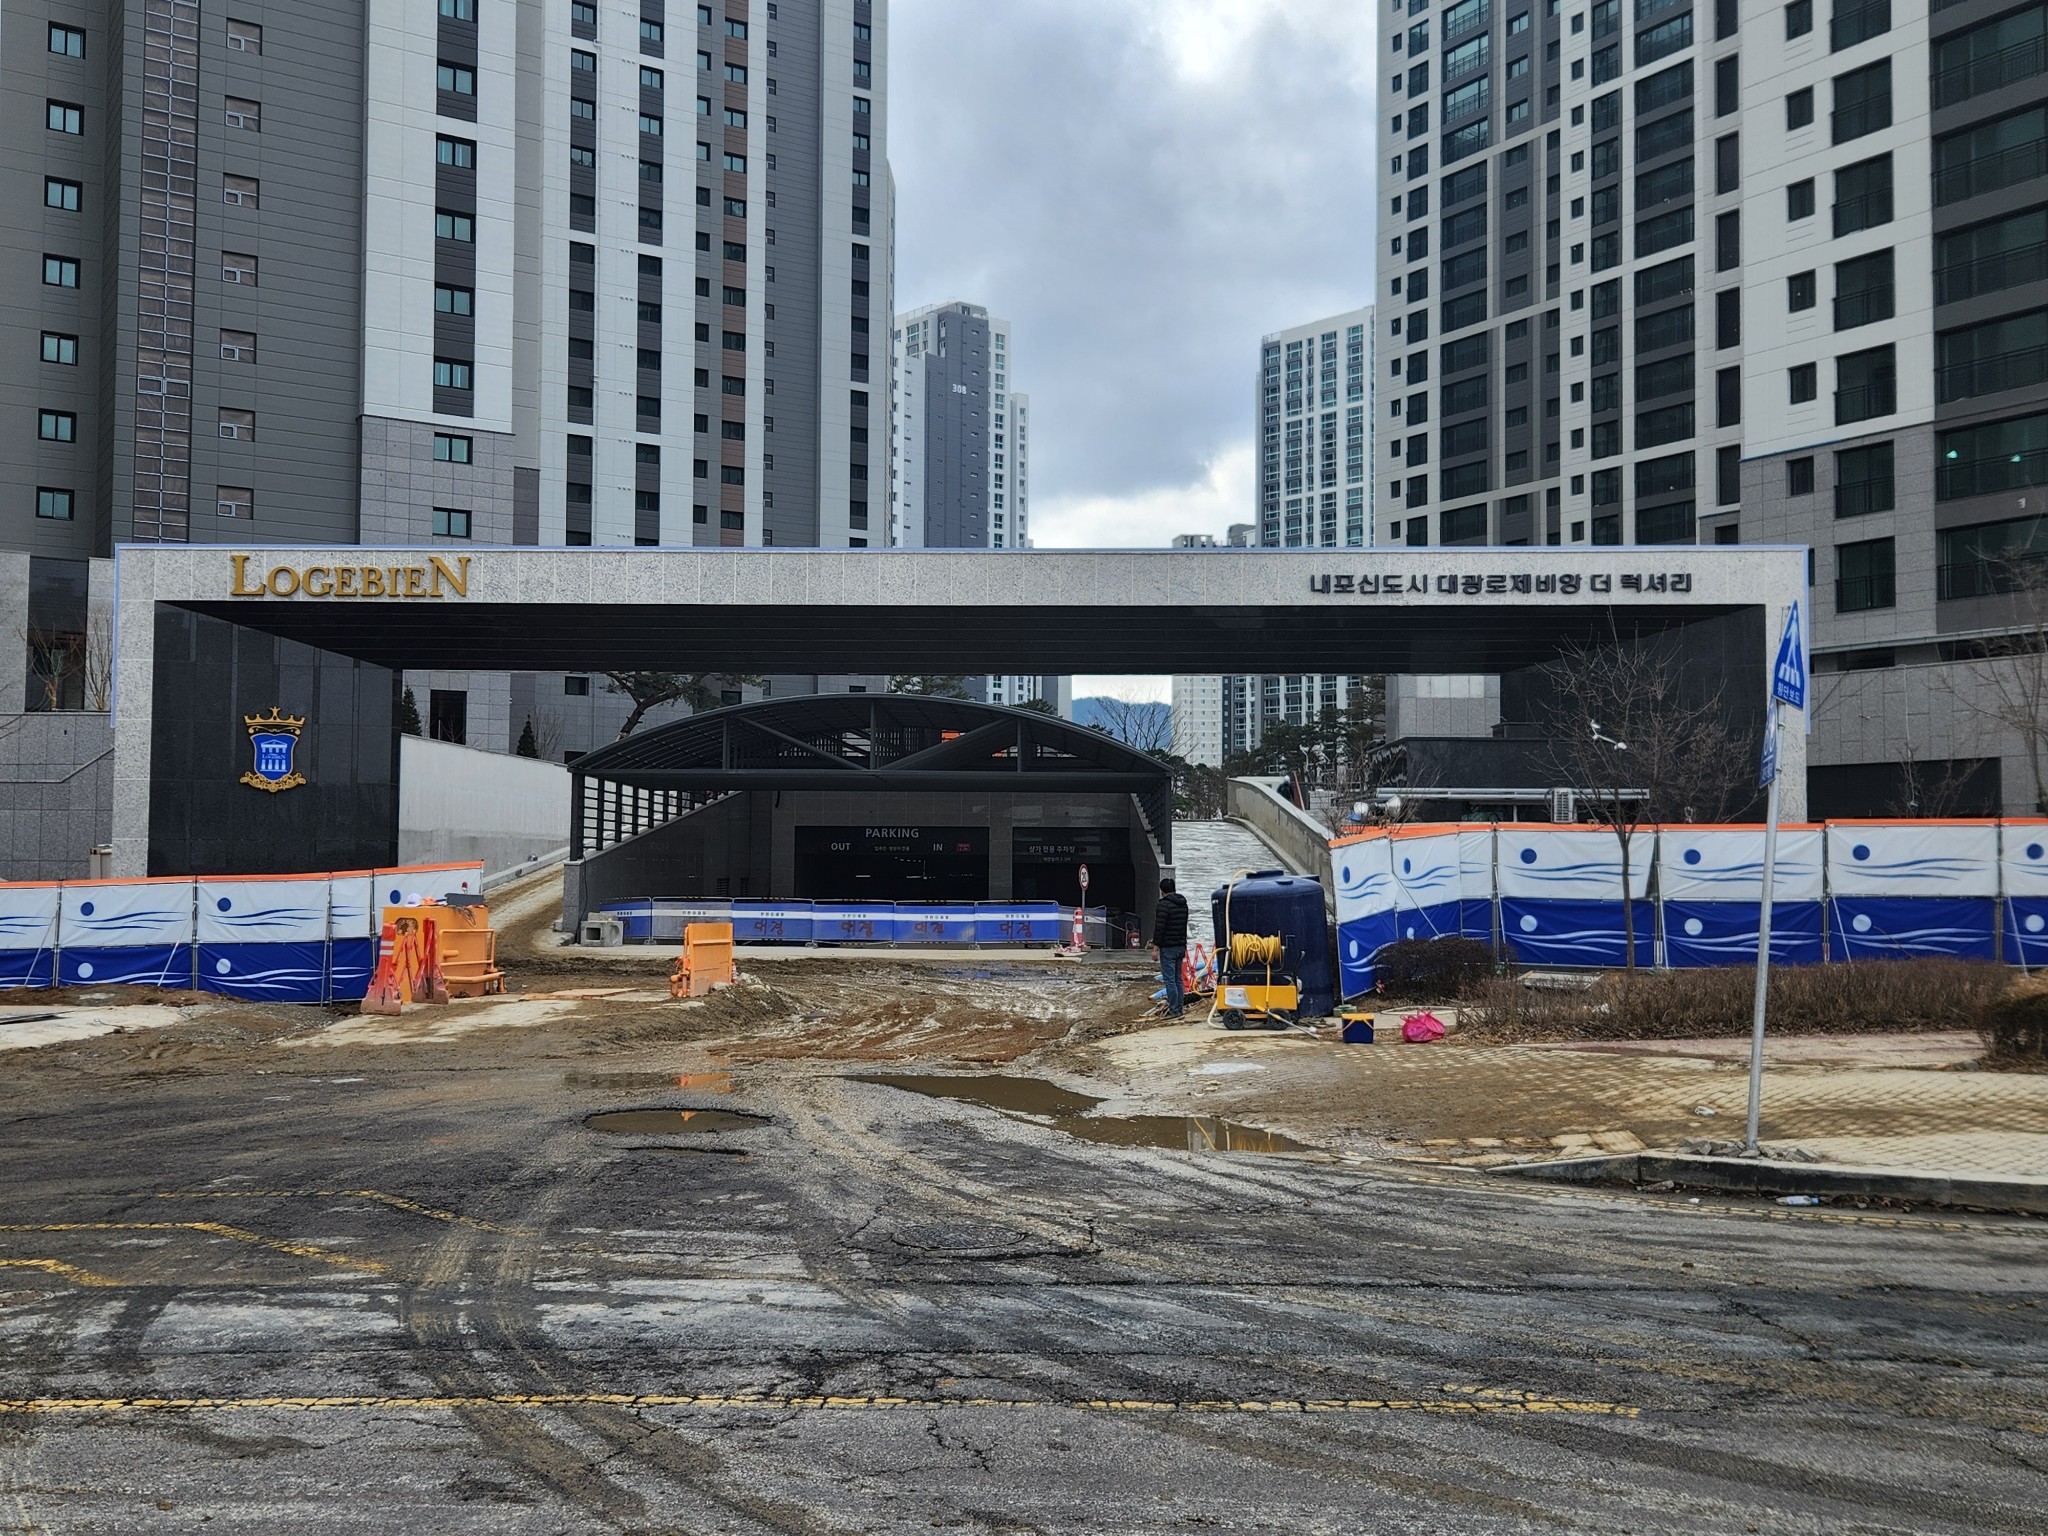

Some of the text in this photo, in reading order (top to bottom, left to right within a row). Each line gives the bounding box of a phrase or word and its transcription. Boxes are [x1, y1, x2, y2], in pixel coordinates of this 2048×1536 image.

[952, 383, 967, 395] 308
[1309, 572, 1693, 595] 내포신도시 대광로제비앙 더 럭셔리
[1777, 682, 1801, 705] 횡단보도
[865, 828, 919, 838] PARKING
[831, 842, 851, 851] OUT
[933, 843, 943, 852] IN
[1028, 845, 1041, 854] 상가
[1042, 845, 1055, 854] 전용
[1056, 845, 1076, 854] 주차장
